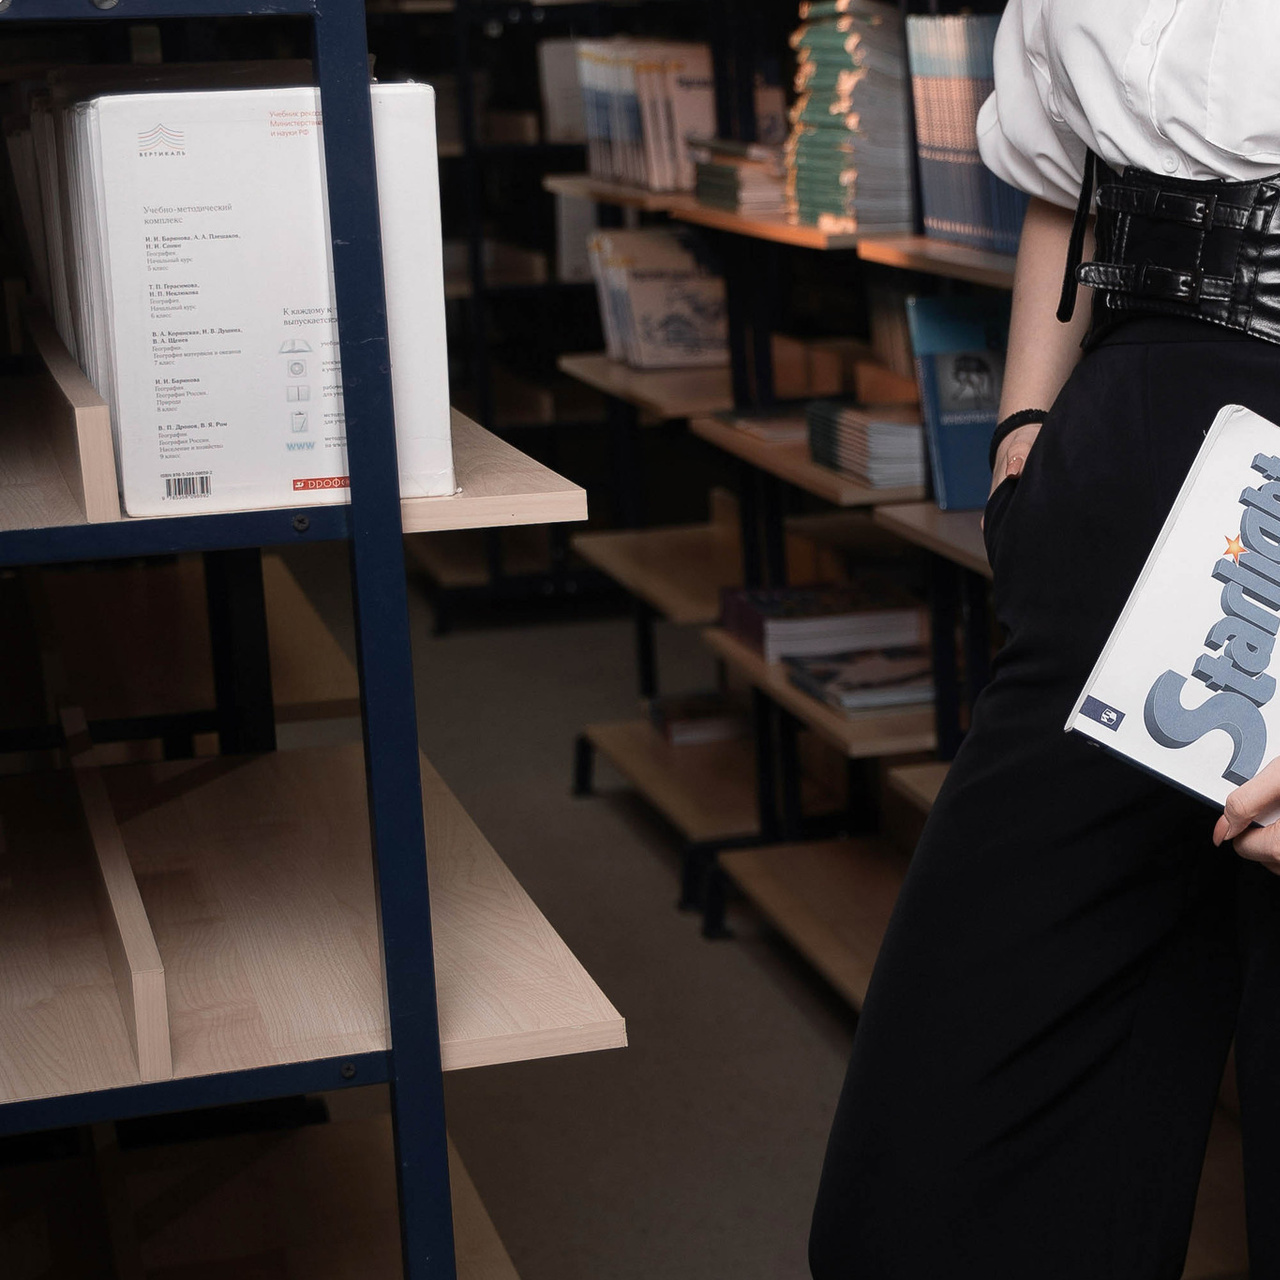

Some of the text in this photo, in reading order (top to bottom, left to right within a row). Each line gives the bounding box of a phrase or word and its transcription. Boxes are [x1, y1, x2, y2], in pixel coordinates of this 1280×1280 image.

[143, 203, 233, 214] Учебно-методический
[144, 217, 183, 225] комплекс
[283, 307, 290, 316] К
[291, 307, 324, 316] каждому
[286, 442, 315, 451] www
